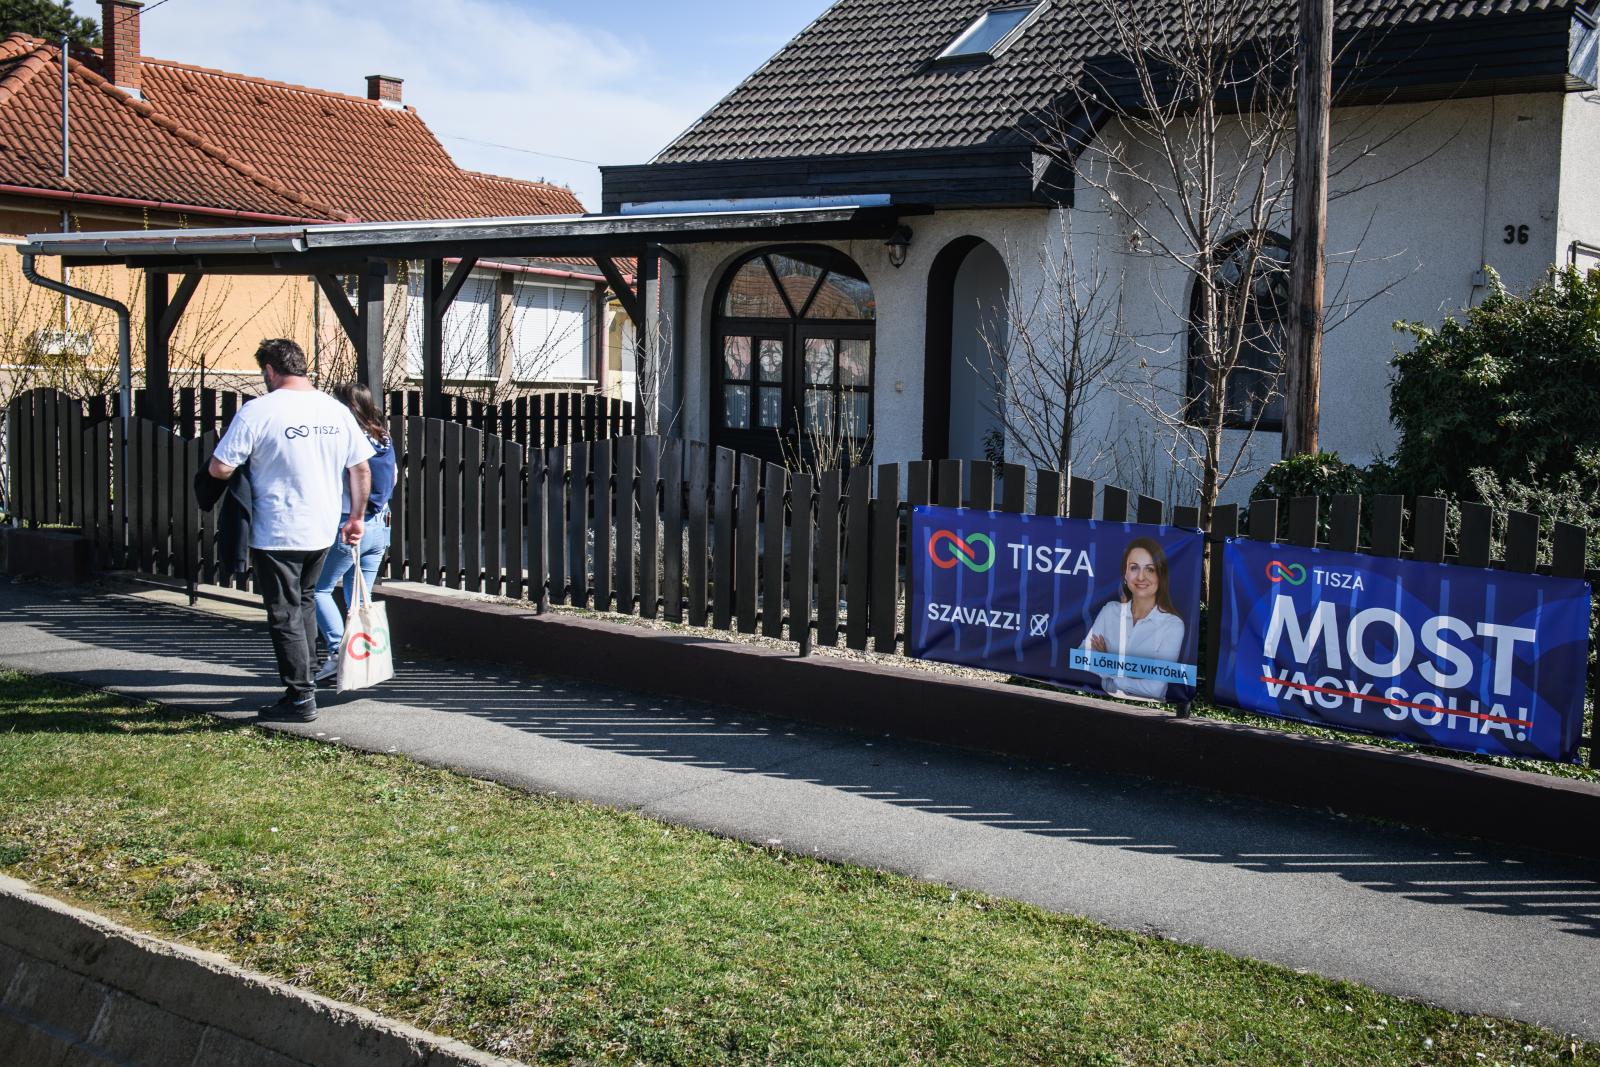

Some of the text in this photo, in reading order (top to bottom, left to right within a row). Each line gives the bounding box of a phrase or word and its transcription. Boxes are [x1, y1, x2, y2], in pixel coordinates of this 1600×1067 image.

[1504, 225, 1529, 245] 36
[1007, 543, 1095, 577] TISZA
[1313, 570, 1364, 592] TISZA
[928, 603, 1020, 631] SZAVAZZ!
[1263, 594, 1536, 696] MOST
[1075, 656, 1188, 679] DR. LŐRINCZ VIKTÓRIA
[1262, 664, 1374, 714] VAGY
[1384, 686, 1528, 742] SOHA!
